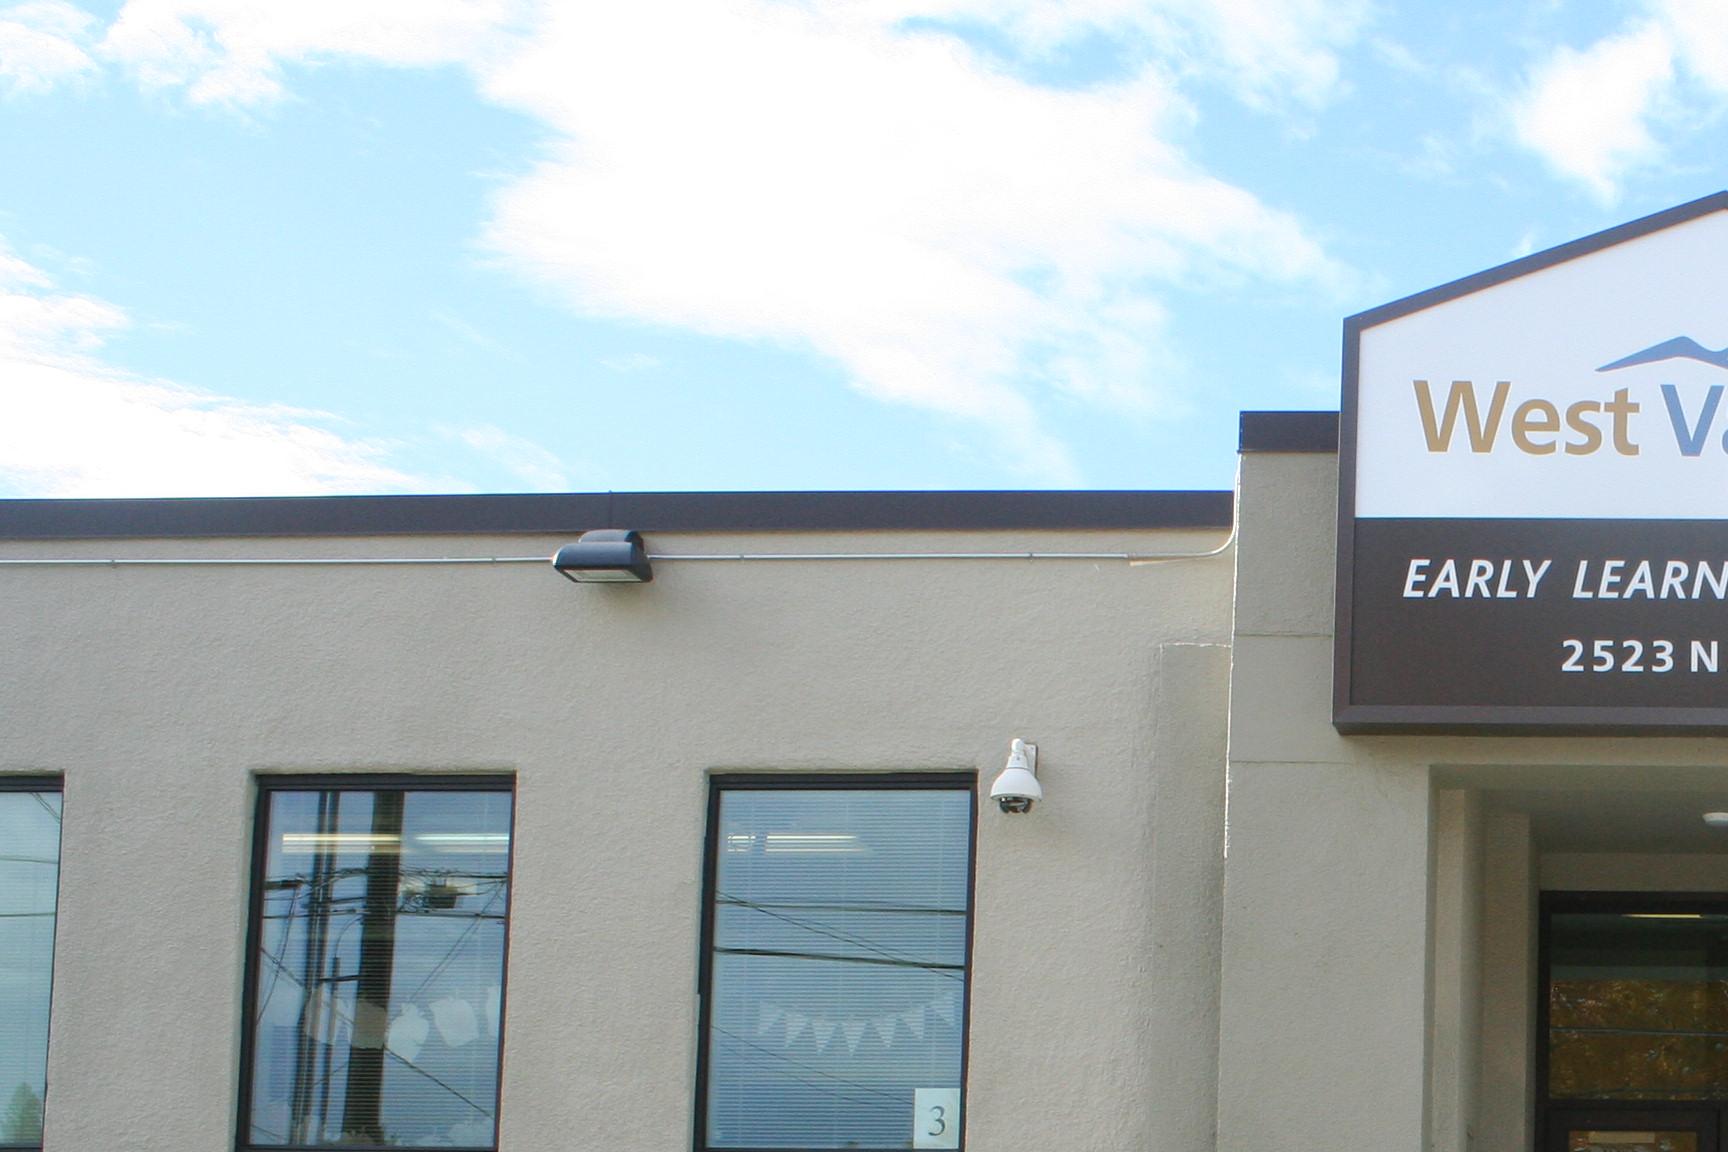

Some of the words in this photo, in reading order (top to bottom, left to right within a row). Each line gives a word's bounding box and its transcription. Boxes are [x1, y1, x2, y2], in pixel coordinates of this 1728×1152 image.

[1413, 379, 1640, 456] West
[1402, 558, 1551, 599] EARLY
[1561, 639, 1674, 673] 2523
[928, 1105, 946, 1136] 3
